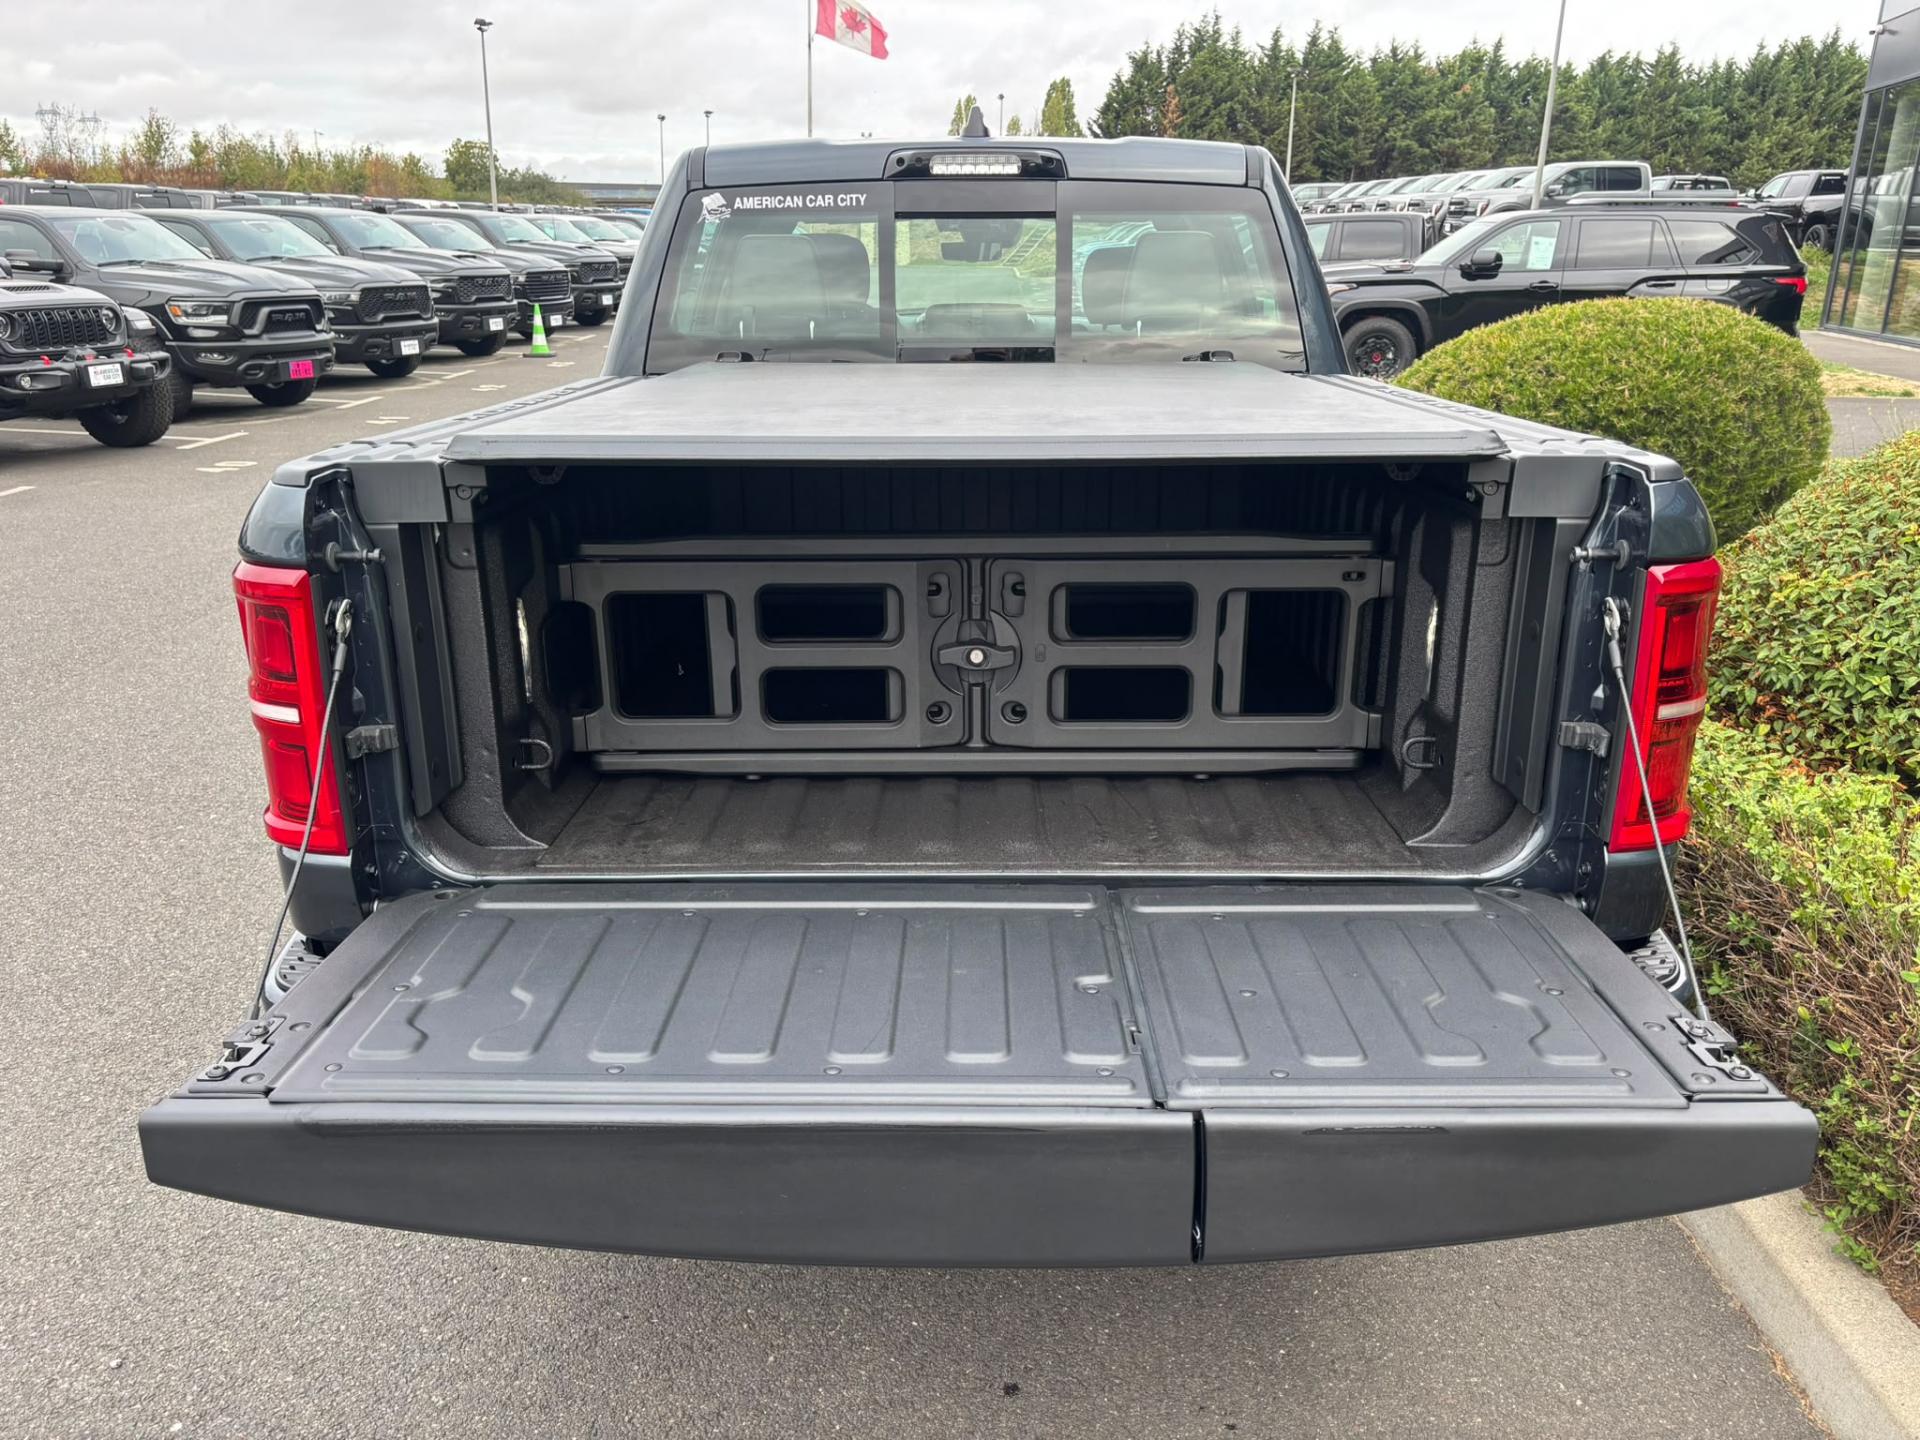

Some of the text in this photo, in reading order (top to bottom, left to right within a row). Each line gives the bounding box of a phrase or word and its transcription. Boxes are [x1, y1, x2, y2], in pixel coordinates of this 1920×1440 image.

[733, 193, 867, 209] AMERICAN CAR CITY
